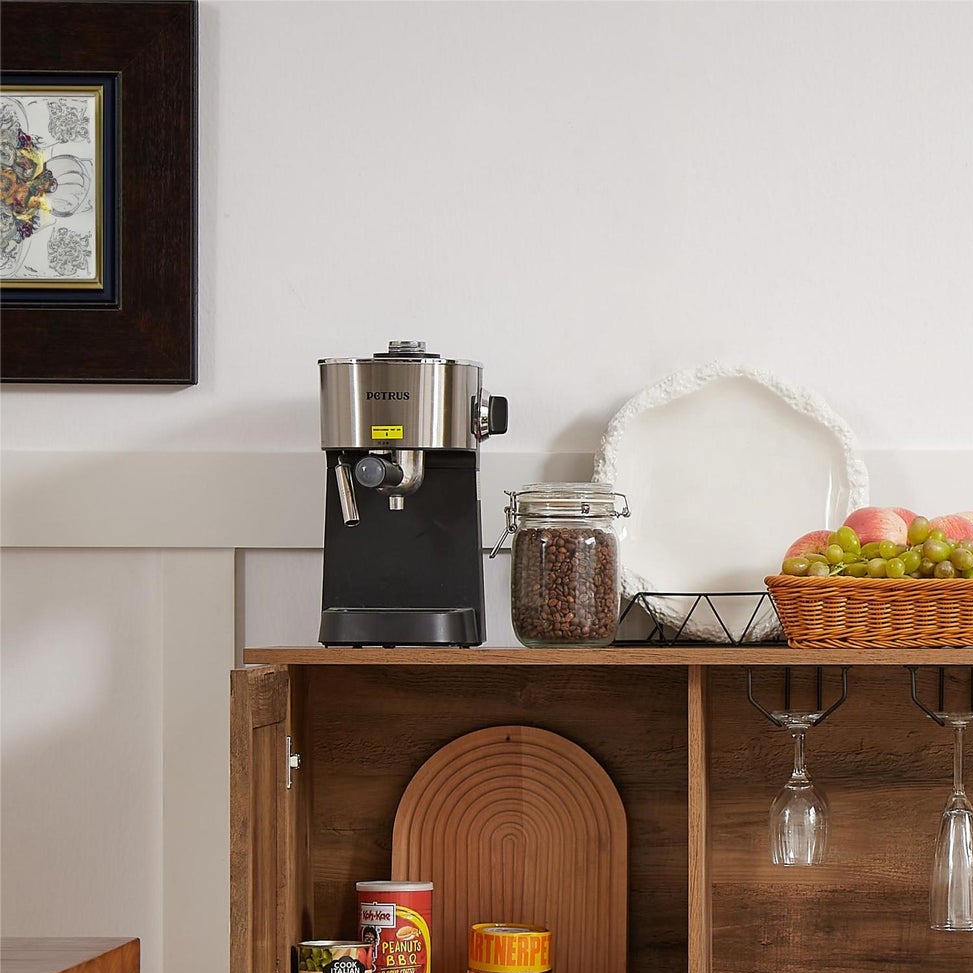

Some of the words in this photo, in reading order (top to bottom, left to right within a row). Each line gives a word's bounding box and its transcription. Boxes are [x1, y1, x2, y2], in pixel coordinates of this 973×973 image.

[366, 391, 410, 401] PETRUS
[382, 939, 421, 954] PEANUTS
[334, 961, 357, 969] COOK
